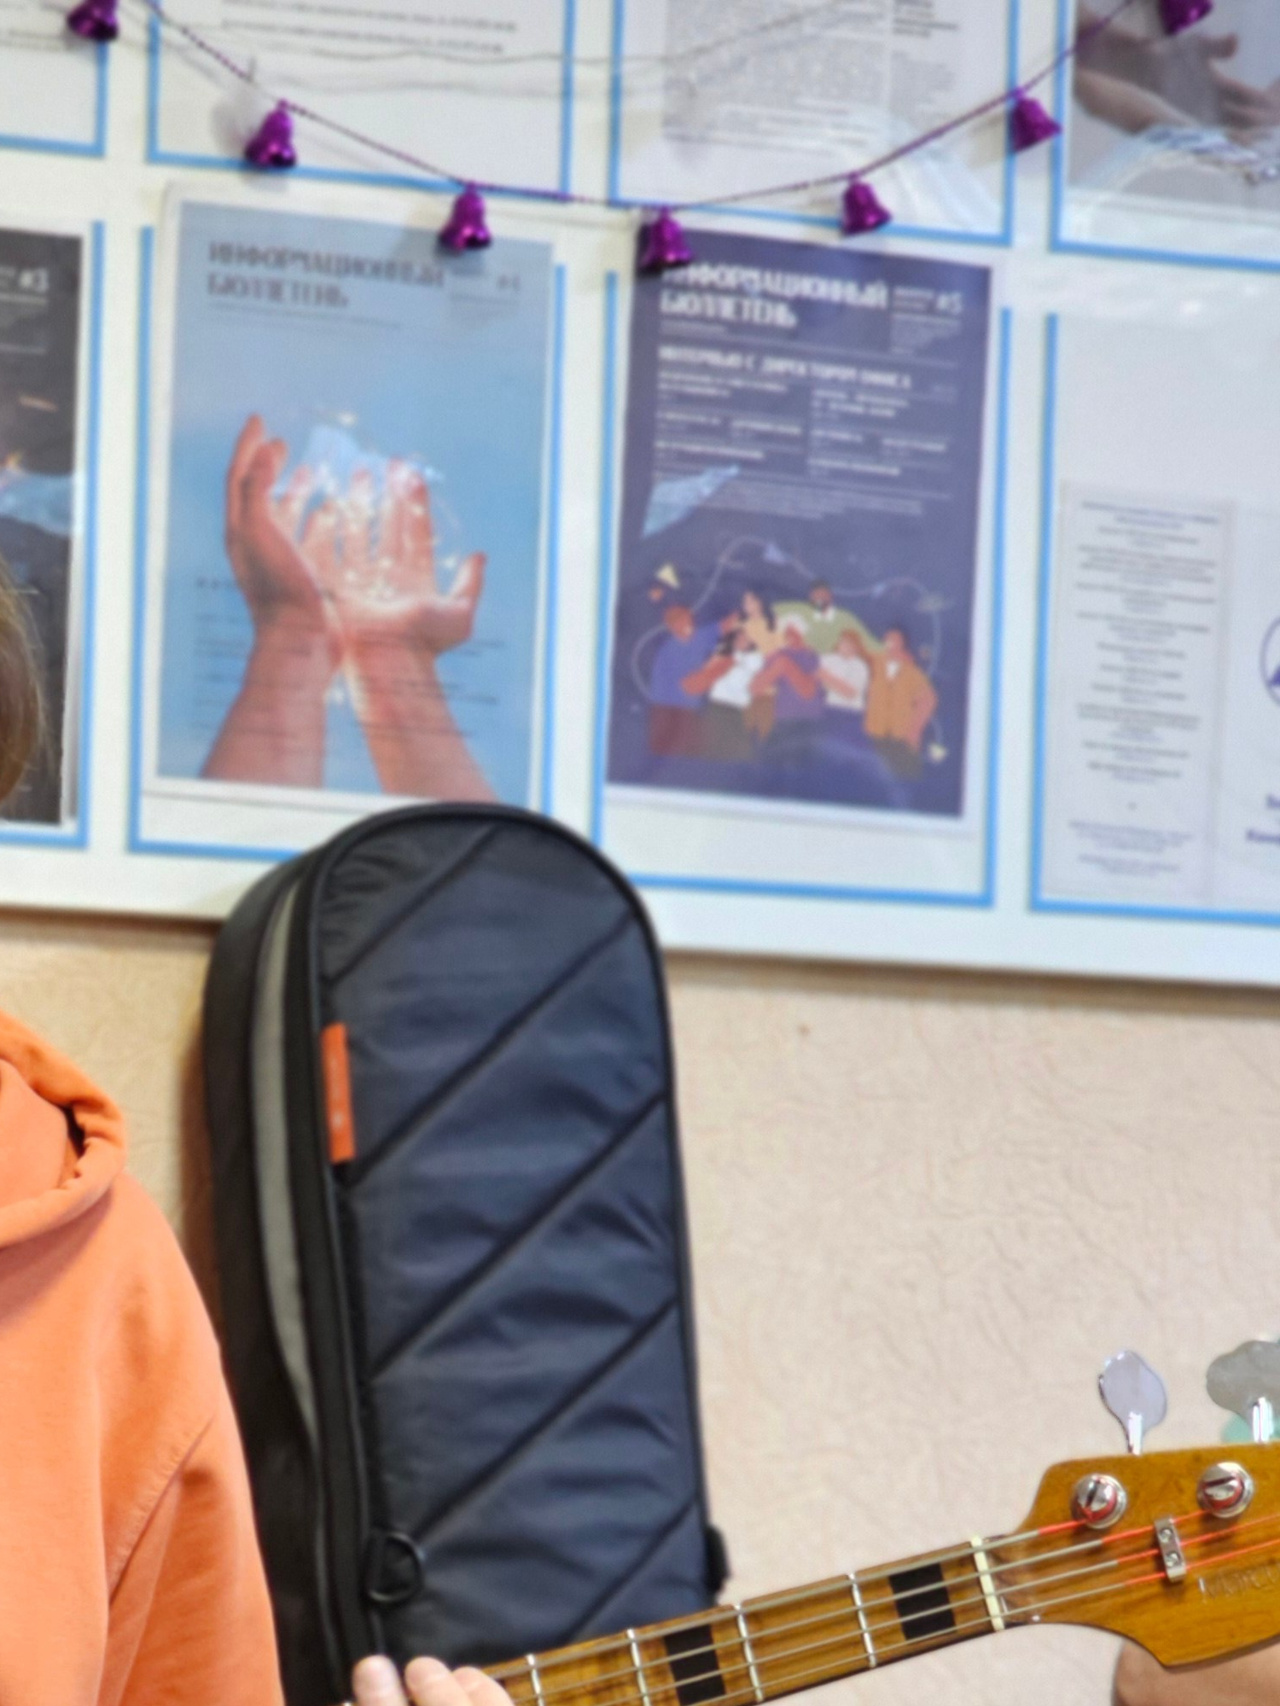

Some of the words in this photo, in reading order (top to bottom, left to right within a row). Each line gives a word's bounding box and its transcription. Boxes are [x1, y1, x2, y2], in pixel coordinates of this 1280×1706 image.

[208, 240, 445, 289] ИНФОРМАЦИОННЫЙ
[207, 272, 350, 308] БЮЛЛЕТЕНЬ
[659, 288, 798, 329] БЮЛЛЕТЕНЬ
